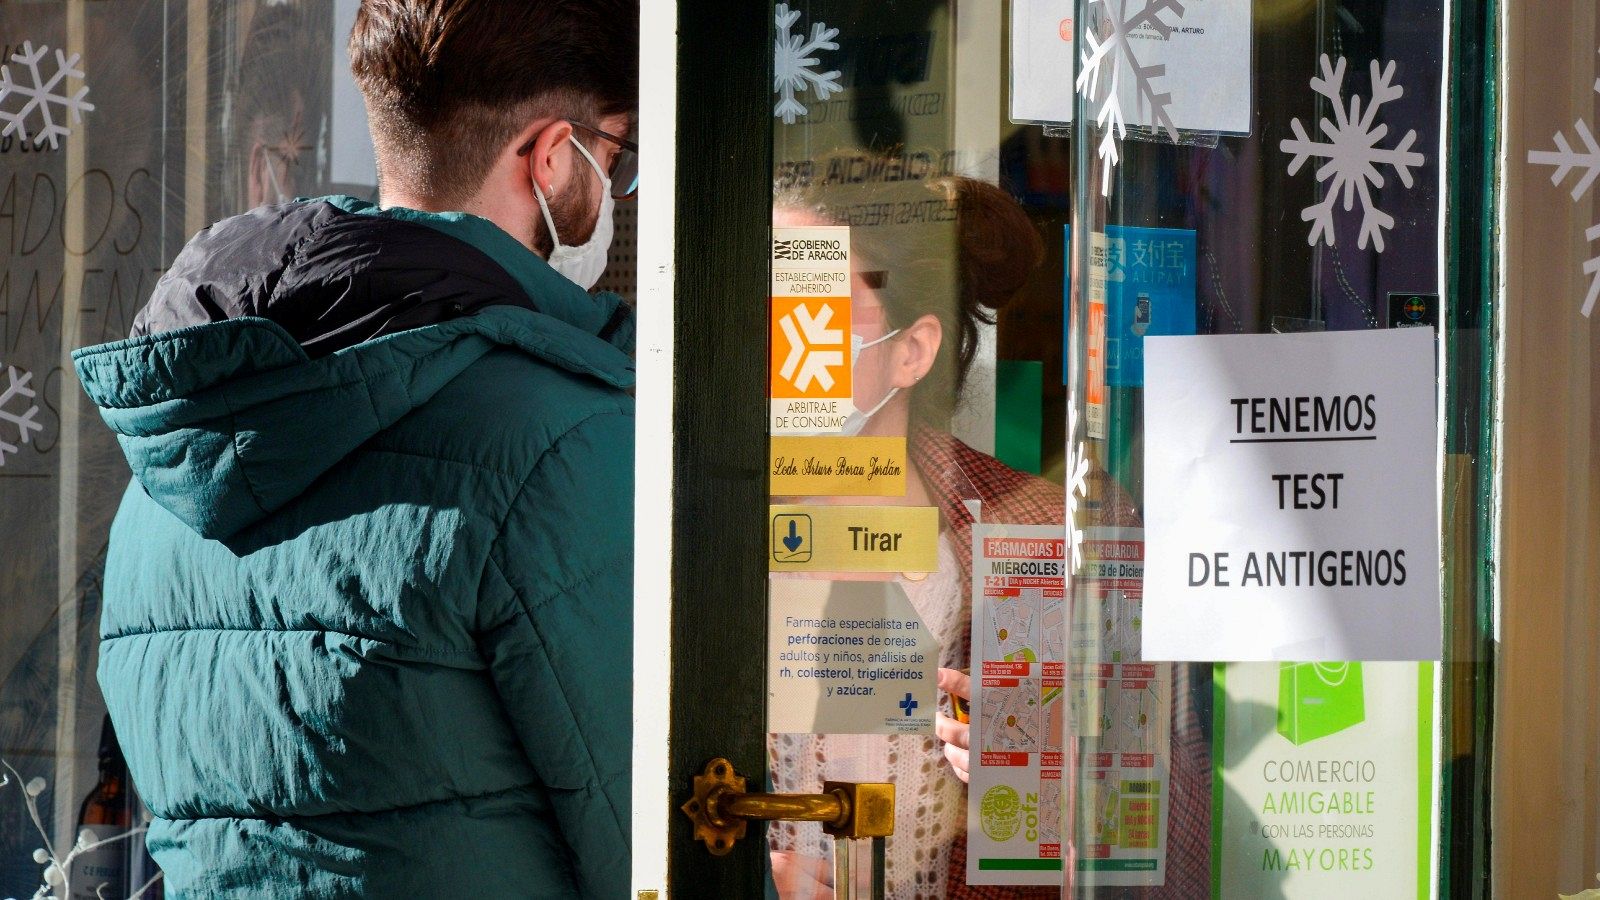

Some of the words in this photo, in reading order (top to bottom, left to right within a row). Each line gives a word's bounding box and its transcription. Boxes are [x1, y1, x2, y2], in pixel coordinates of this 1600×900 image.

[1181, 27, 1205, 35] ARTURO
[792, 239, 841, 250] GOBIERNO
[792, 250, 805, 261] DE
[808, 250, 847, 261] ARAGON
[1131, 239, 1184, 268] 支付宝
[775, 272, 846, 282] ESTABLECIMIENTO
[790, 283, 832, 294] ADHERIDO
[787, 401, 837, 414] ARBITRAJE
[1230, 394, 1376, 434] TENEMOS
[775, 416, 789, 428] DE
[802, 456, 833, 476] Arturo
[835, 456, 865, 476] Borau
[867, 456, 901, 481] Jordán
[1272, 473, 1344, 510] TEST
[848, 527, 903, 551] Tirar
[988, 541, 1053, 557] FARMACIAS
[1105, 543, 1140, 559] GUARDIA
[992, 559, 1059, 576] MIÉRCOLES
[1108, 564, 1118, 578] de
[1119, 564, 1143, 578] Diciem
[1188, 552, 1230, 587] DE
[1241, 549, 1407, 587] ANTIGENOS
[984, 576, 1006, 587] T-21
[786, 616, 836, 629] Farmacia
[839, 618, 902, 631] especialista
[905, 620, 919, 630] en
[788, 634, 864, 646] perforaciones
[867, 635, 881, 646] de
[884, 635, 917, 648] orejas
[779, 650, 820, 661] adultos
[823, 653, 830, 663] y
[833, 652, 865, 663] niños,
[867, 651, 907, 663] análisis
[910, 652, 924, 663] de
[780, 666, 794, 679] rh,
[797, 667, 854, 679] colesterol,
[857, 668, 923, 680] triglicéridos
[826, 686, 833, 697] y
[836, 684, 876, 696] azúcar.
[1263, 760, 1376, 783] COMERCIO
[1262, 791, 1375, 814] AMIGABLE
[1022, 792, 1038, 842] cofz
[1262, 824, 1289, 838] CON
[1293, 824, 1314, 838] LAS
[1318, 824, 1374, 839] PERSONAS
[1262, 848, 1373, 871] MAYORES
